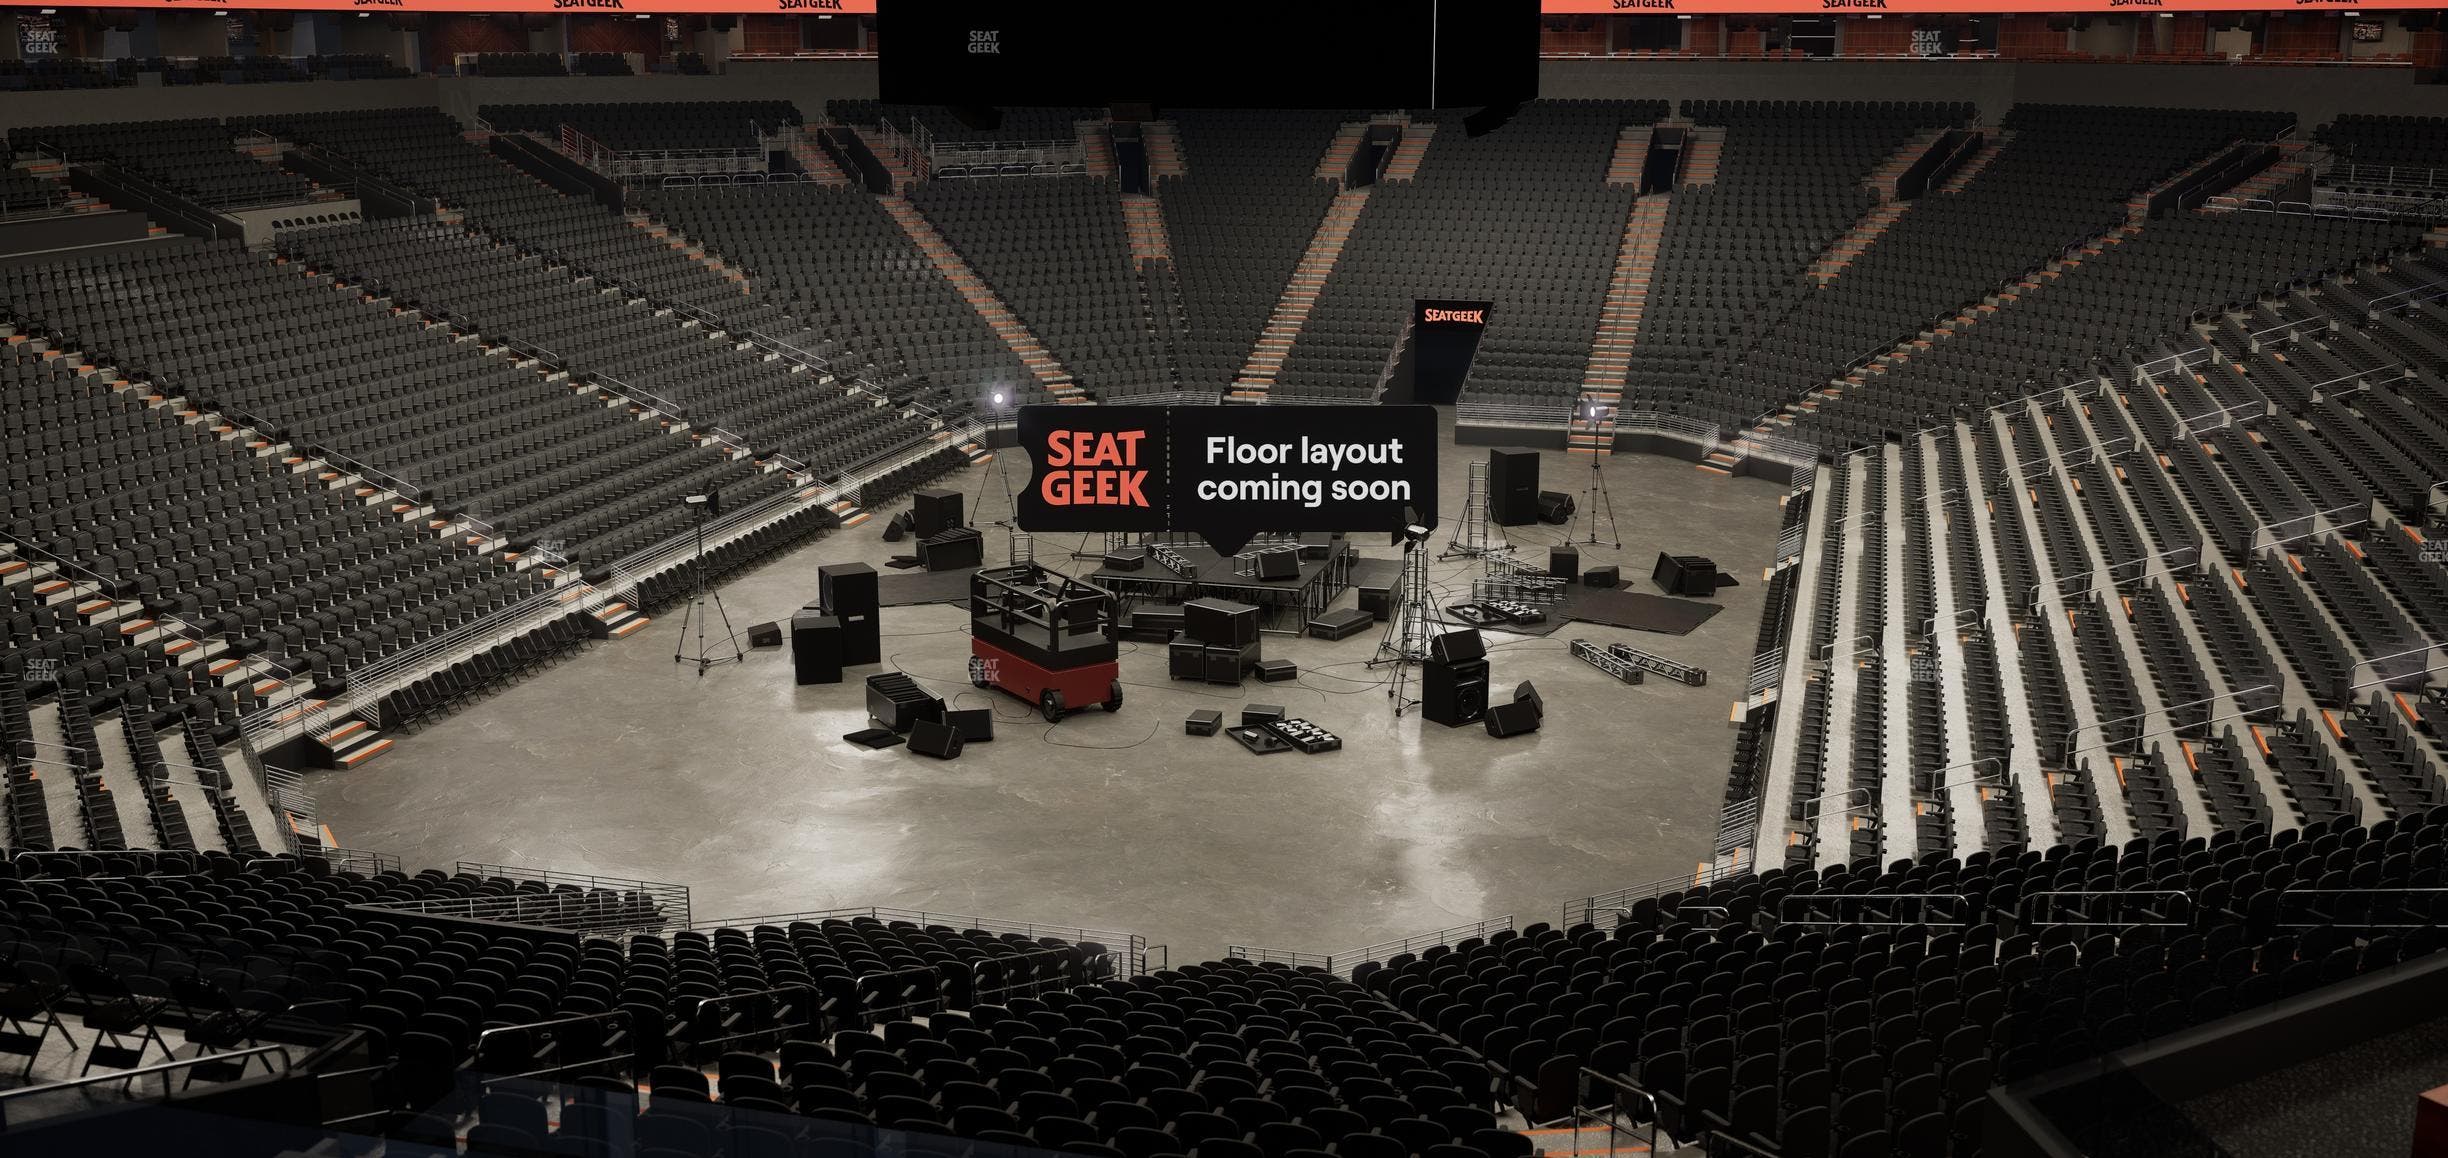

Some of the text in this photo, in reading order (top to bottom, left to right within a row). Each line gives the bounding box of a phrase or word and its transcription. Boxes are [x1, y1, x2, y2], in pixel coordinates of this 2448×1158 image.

[1425, 308, 1484, 324] SEATGEEK
[1047, 429, 1146, 467] SEAT
[1206, 436, 1403, 471] Floor layout
[1041, 470, 1150, 508] GEEK
[1197, 472, 1411, 508] coming soon
